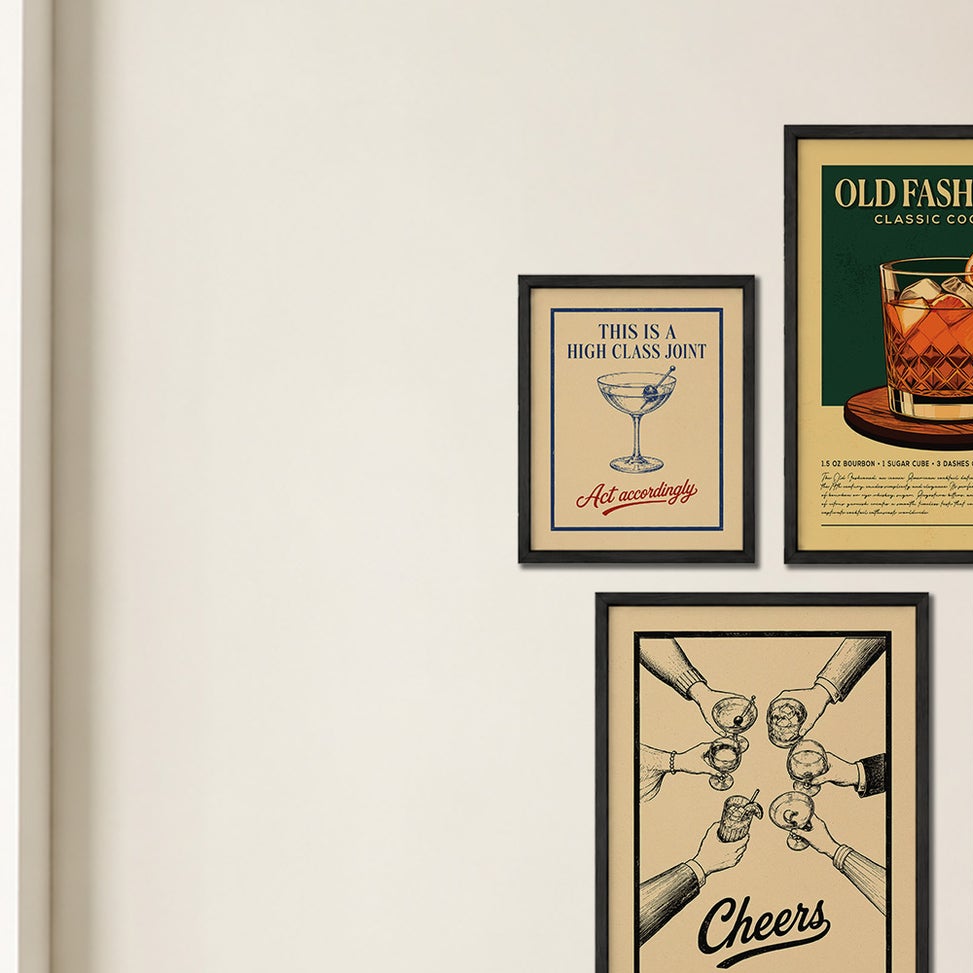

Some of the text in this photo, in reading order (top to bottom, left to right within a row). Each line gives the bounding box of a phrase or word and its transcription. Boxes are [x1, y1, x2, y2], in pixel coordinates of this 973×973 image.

[834, 178, 896, 208] OLD
[874, 214, 941, 225] CLASSIC
[598, 323, 676, 340] THIS IS A
[567, 343, 707, 360] HIGH CLASS JOINT
[576, 478, 698, 509] Act accordingly
[697, 895, 831, 960] Cheers
